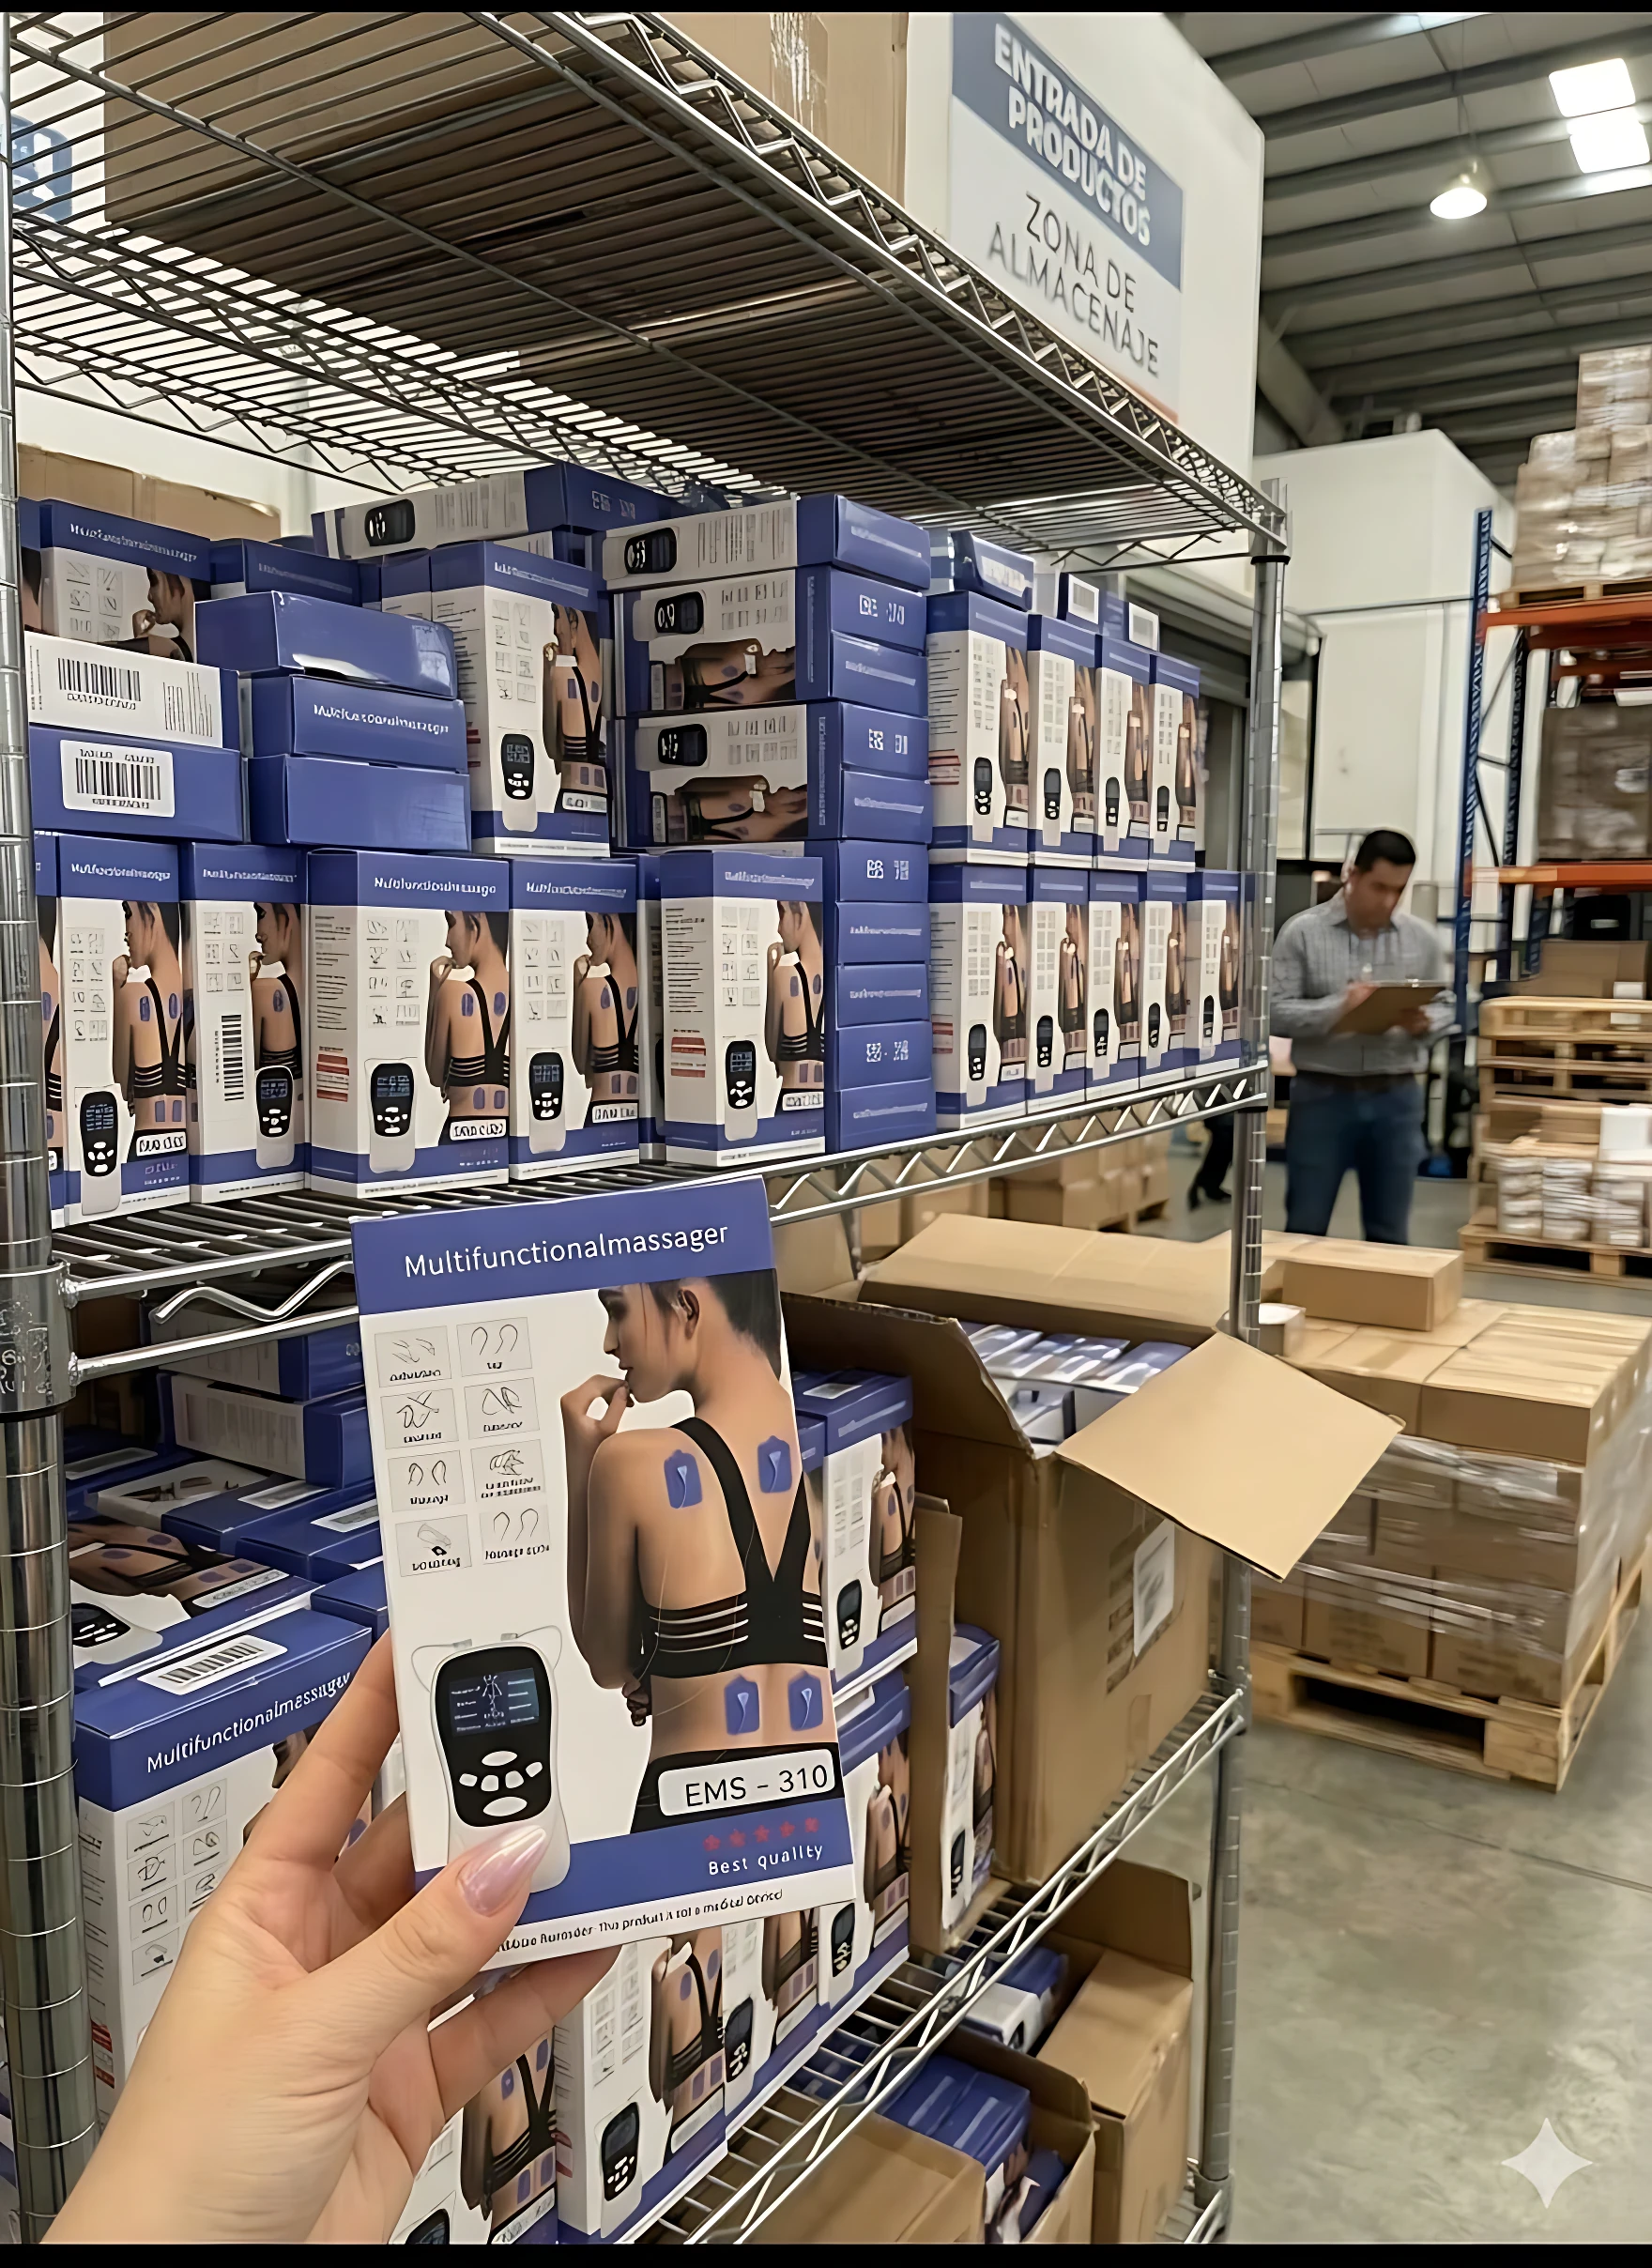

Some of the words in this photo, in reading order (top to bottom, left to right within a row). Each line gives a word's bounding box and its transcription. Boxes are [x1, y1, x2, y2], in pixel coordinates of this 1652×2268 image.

[994, 23, 1112, 165] ENTRADA
[1117, 141, 1147, 201] DE
[1008, 84, 1151, 246] PRODUCTOS
[987, 222, 1159, 377] ALMACENAJE
[1025, 191, 1100, 288] ZONA
[1106, 258, 1137, 314] DE
[404, 1225, 728, 1278] Multifunctionalmassager
[685, 1776, 746, 1807] EMS
[778, 1765, 828, 1793] 310
[709, 1858, 748, 1876] Best
